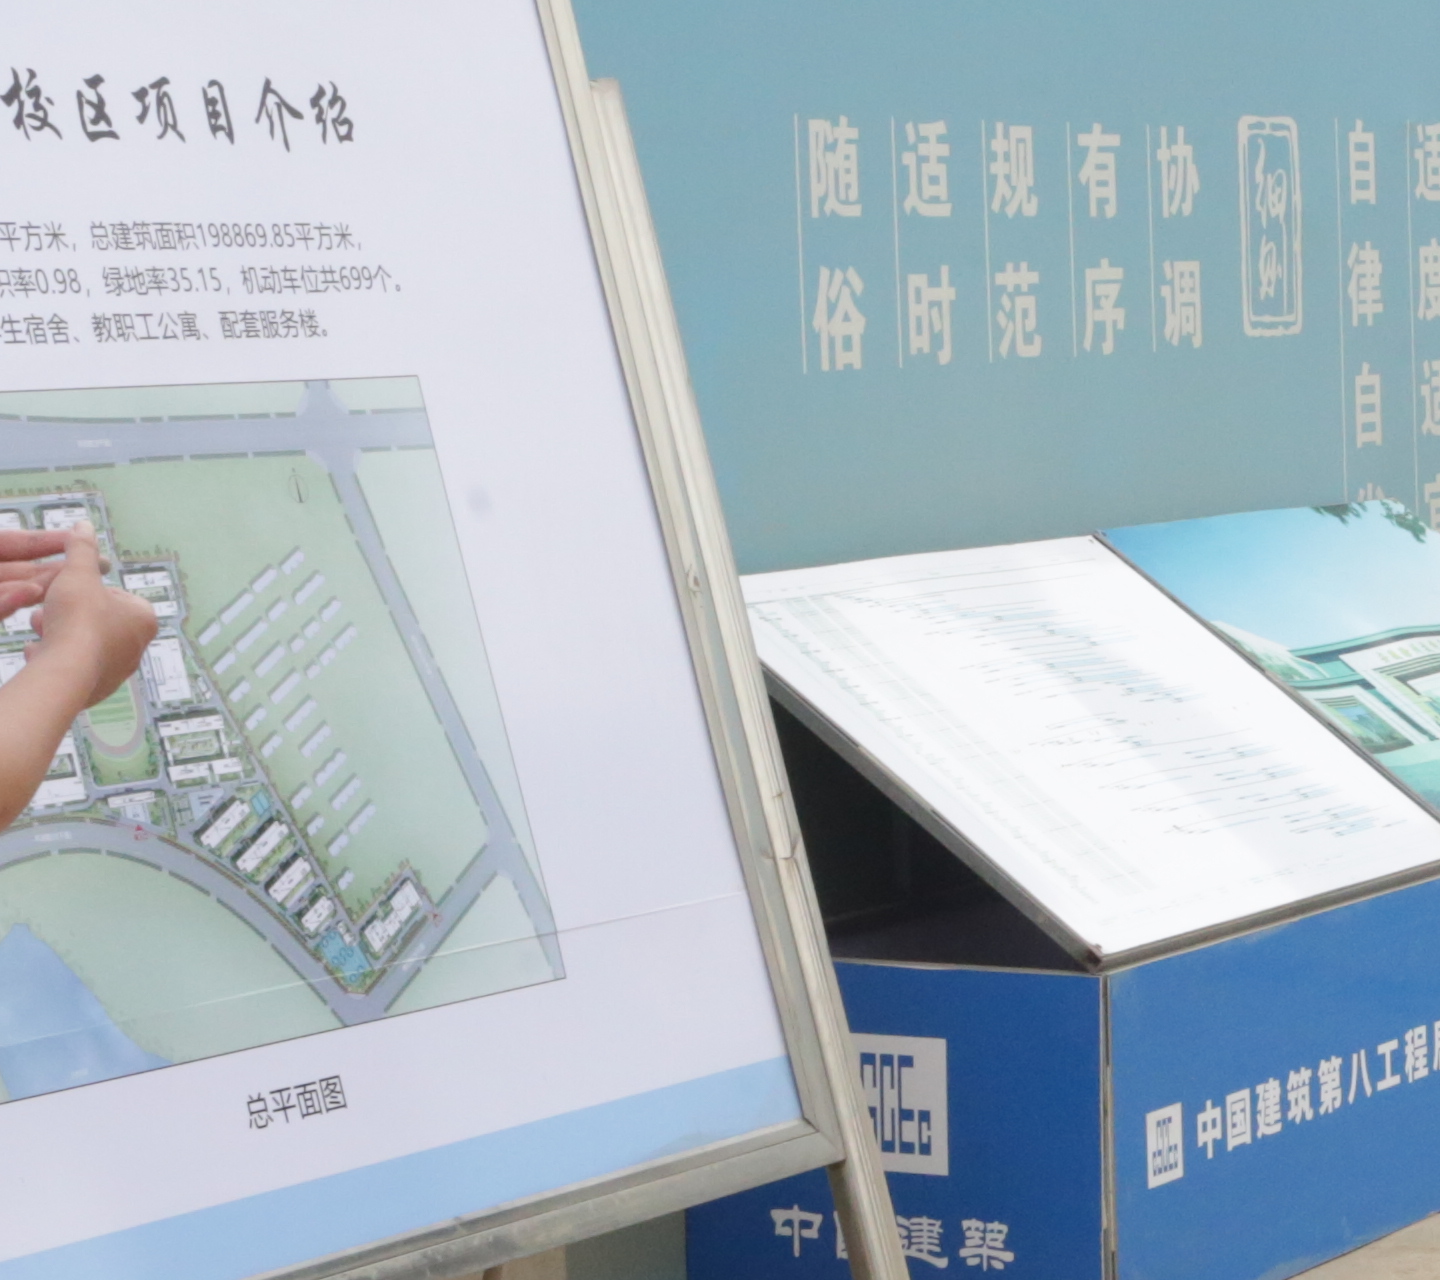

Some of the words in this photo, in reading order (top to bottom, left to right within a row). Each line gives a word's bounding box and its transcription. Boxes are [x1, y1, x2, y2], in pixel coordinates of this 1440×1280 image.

[808, 114, 867, 372] 随俗
[901, 119, 957, 366] 适时
[989, 121, 1043, 359] 规范
[1076, 122, 1126, 356] 有序
[1156, 124, 1203, 349] 协调
[1347, 118, 1386, 502] 自律自
[247, 1074, 348, 1130] 总平面图
[770, 1203, 1016, 1273] 中建築
